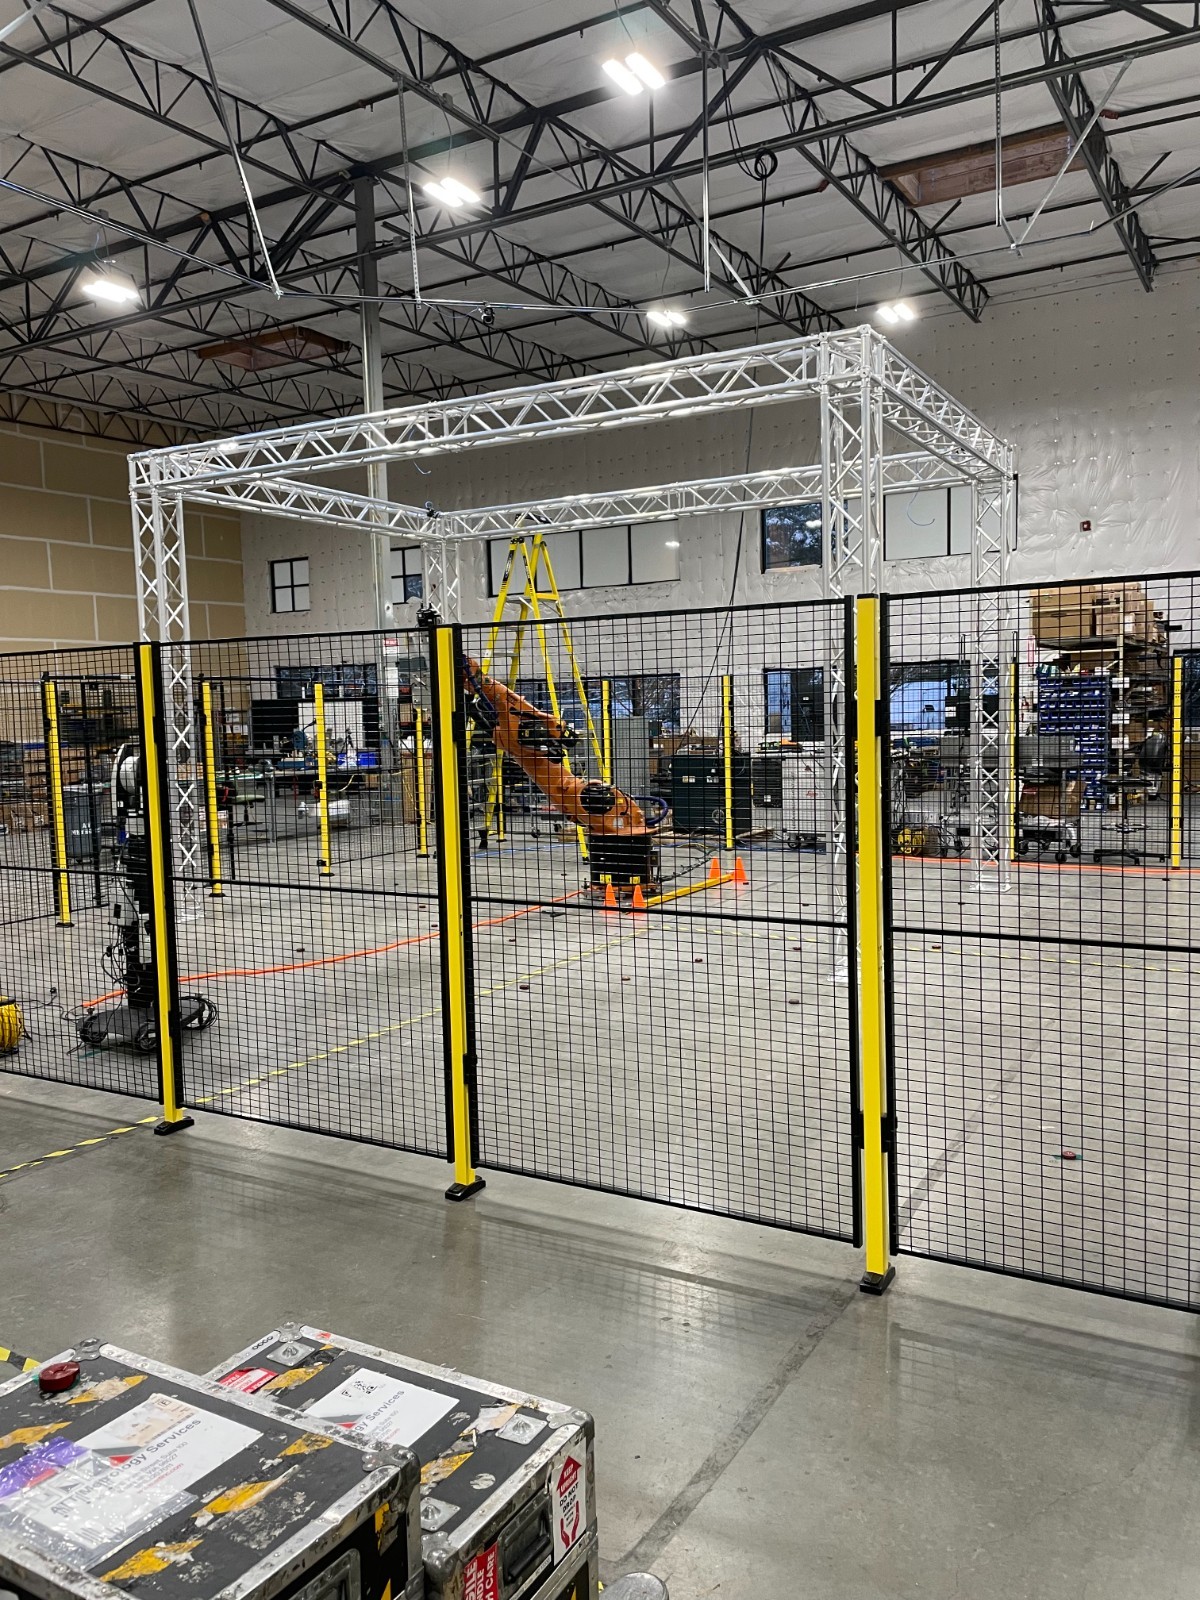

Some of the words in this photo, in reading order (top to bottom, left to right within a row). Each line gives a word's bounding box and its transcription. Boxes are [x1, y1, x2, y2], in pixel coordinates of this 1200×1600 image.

[365, 1390, 405, 1421] Services
[145, 1418, 202, 1454] Services
[563, 1463, 574, 1480] KEEP
[560, 1495, 568, 1507] DO
[568, 1481, 579, 1498] NOT
[563, 1494, 576, 1513] DROP
[485, 1551, 495, 1590] CARE
